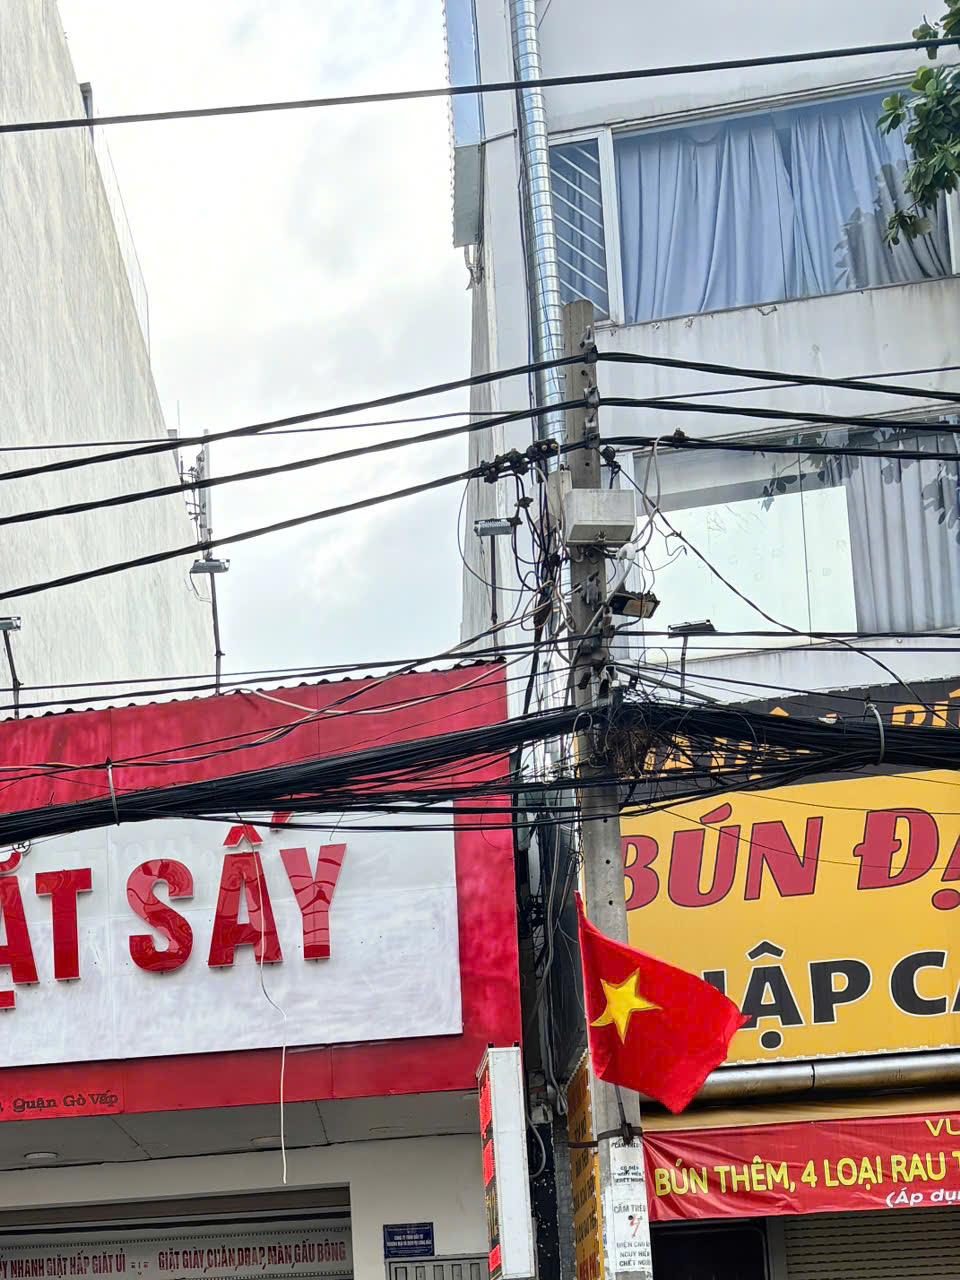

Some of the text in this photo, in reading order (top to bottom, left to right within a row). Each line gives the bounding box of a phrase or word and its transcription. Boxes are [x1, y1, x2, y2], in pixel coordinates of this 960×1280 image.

[620, 802, 960, 912] BÚN Đ
[126, 810, 347, 975] SẤY
[889, 949, 960, 1017] C
[12, 1096, 57, 1113] Quận
[63, 1094, 86, 1107] Gò
[88, 1090, 118, 1107] Vấp
[654, 1158, 708, 1196] BÚN
[714, 1155, 796, 1193] THÊM,
[801, 1160, 817, 1188] 4
[824, 1155, 883, 1190] LOẠI
[891, 1151, 946, 1183] RAU
[885, 1187, 923, 1208] (Áp
[10, 1259, 44, 1279] NHANH
[70, 1250, 90, 1276] HẤP
